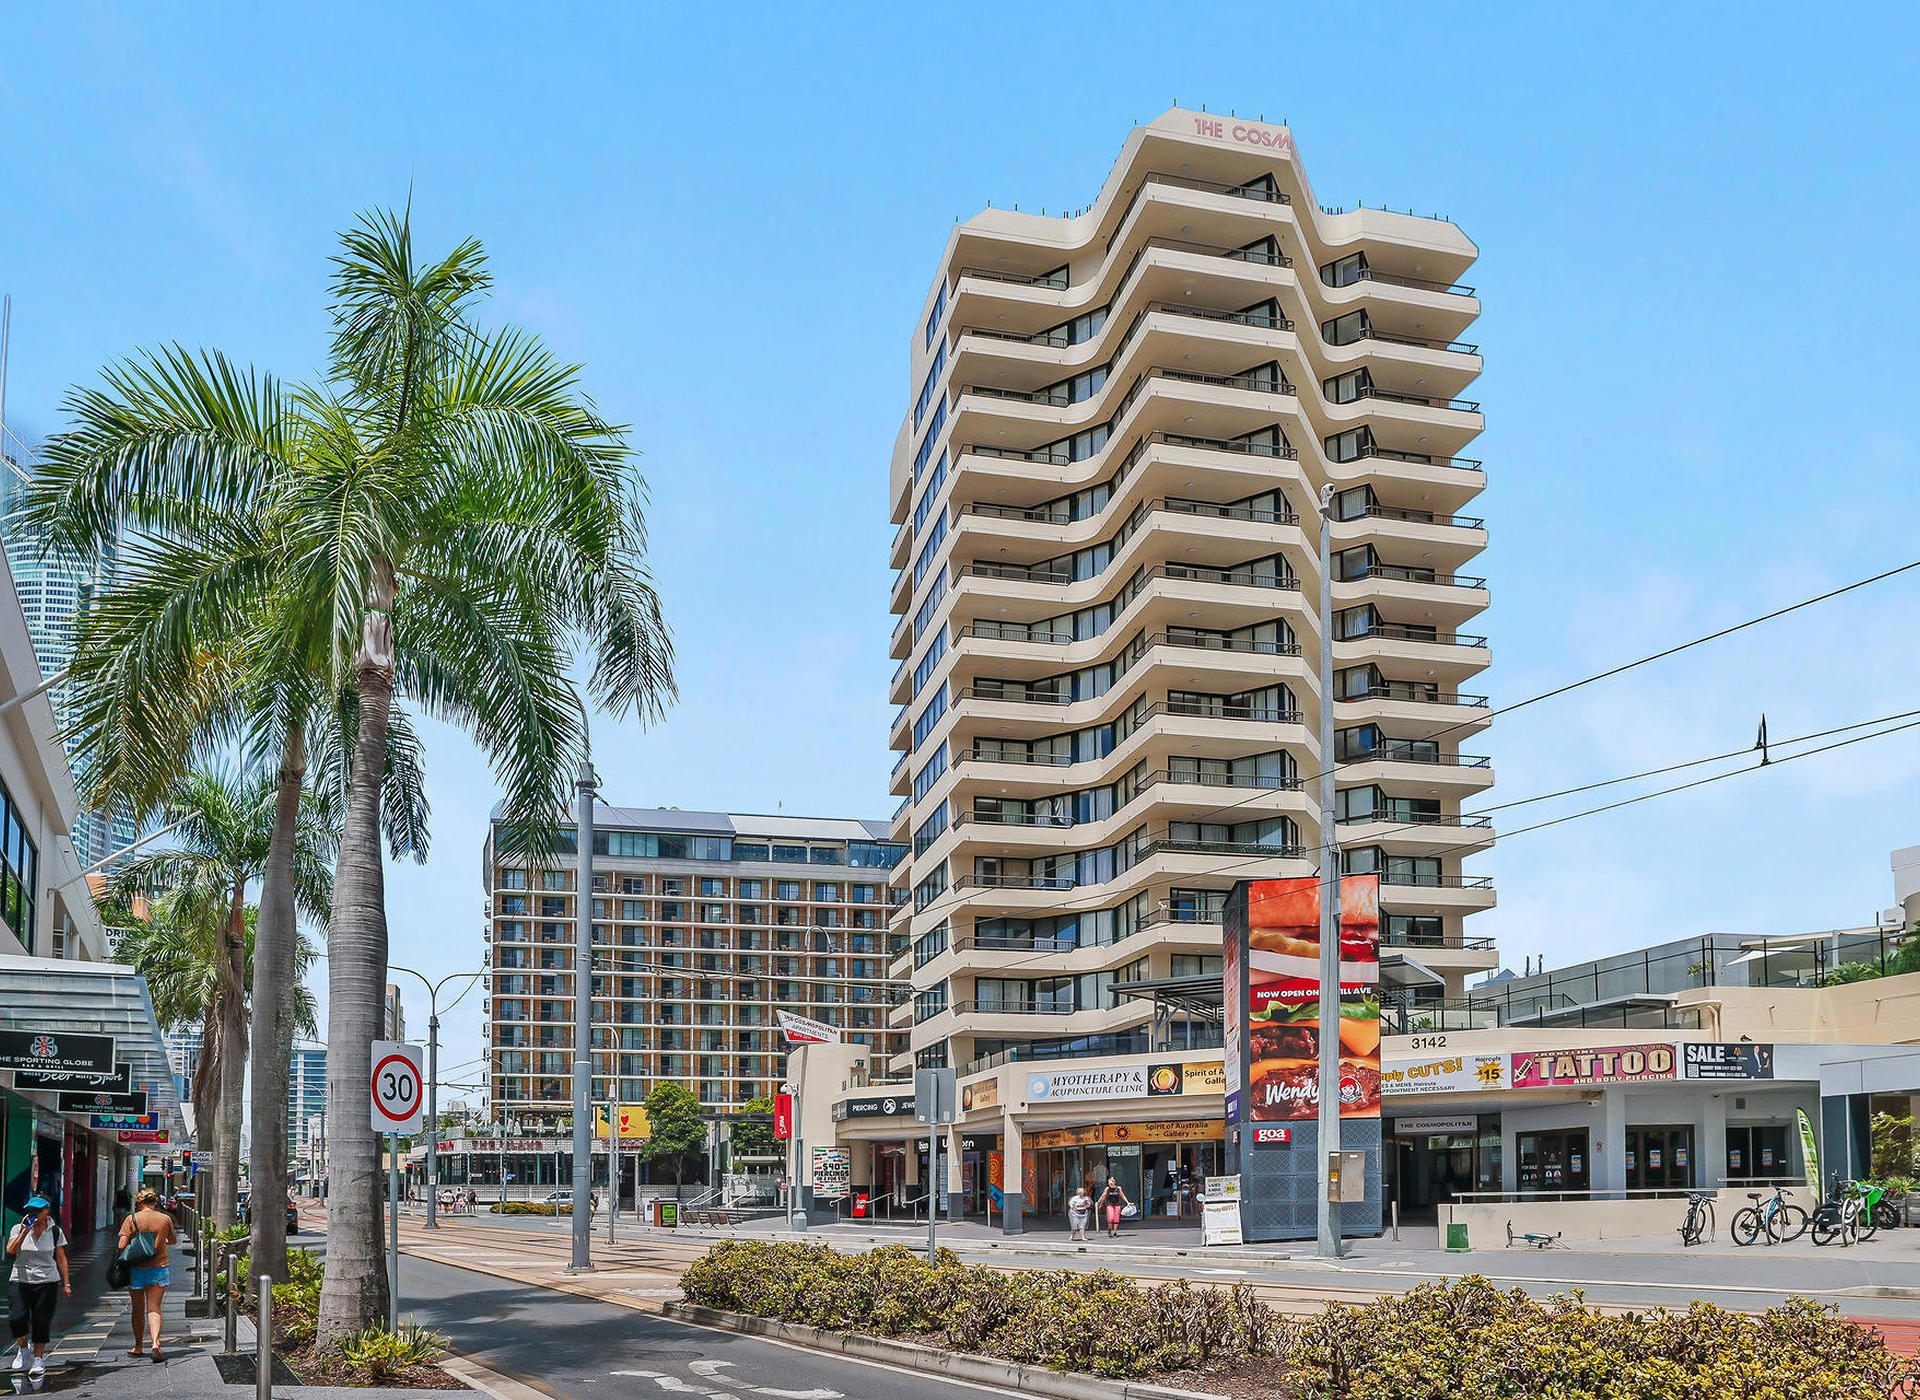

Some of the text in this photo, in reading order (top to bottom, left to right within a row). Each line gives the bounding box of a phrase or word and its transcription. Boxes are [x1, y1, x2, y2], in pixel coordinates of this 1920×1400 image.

[1194, 118, 1292, 150] THE COSM
[106, 928, 132, 938] DRIV
[1257, 990, 1280, 998] NOW
[1282, 989, 1303, 998] OPEN
[1304, 989, 1320, 997] ON
[1353, 987, 1372, 995] AVE
[792, 1024, 829, 1039] APARTMENTS
[794, 1017, 838, 1035] COSMOPOLITAN
[1411, 1035, 1447, 1049] 3142
[1687, 1045, 1725, 1063] SALE
[14, 1056, 61, 1065] SPORTING
[63, 1059, 94, 1067] GLOBE
[1534, 1048, 1674, 1080] TATTOO
[1184, 1069, 1207, 1078] Spirit
[1208, 1068, 1217, 1076] of
[1380, 1057, 1463, 1082] mply CUTS!
[90, 1074, 124, 1085] Sport
[1051, 1072, 1130, 1087] MYOTHERAPY
[1132, 1071, 1143, 1083] &
[1205, 1077, 1225, 1085] Galle
[1596, 1075, 1623, 1083] BODY
[1626, 1073, 1675, 1082] PIERCING
[382, 1072, 413, 1102] 30
[1050, 1084, 1145, 1097] ACUPUNCTURE CLINIC
[1264, 1077, 1320, 1106] Wendy
[852, 1103, 878, 1112] PIERCING
[900, 1101, 915, 1109] JEWE
[1145, 1121, 1209, 1132] Spirit of Australia
[1162, 1130, 1190, 1138] Gallery
[1258, 1128, 1286, 1142] goa
